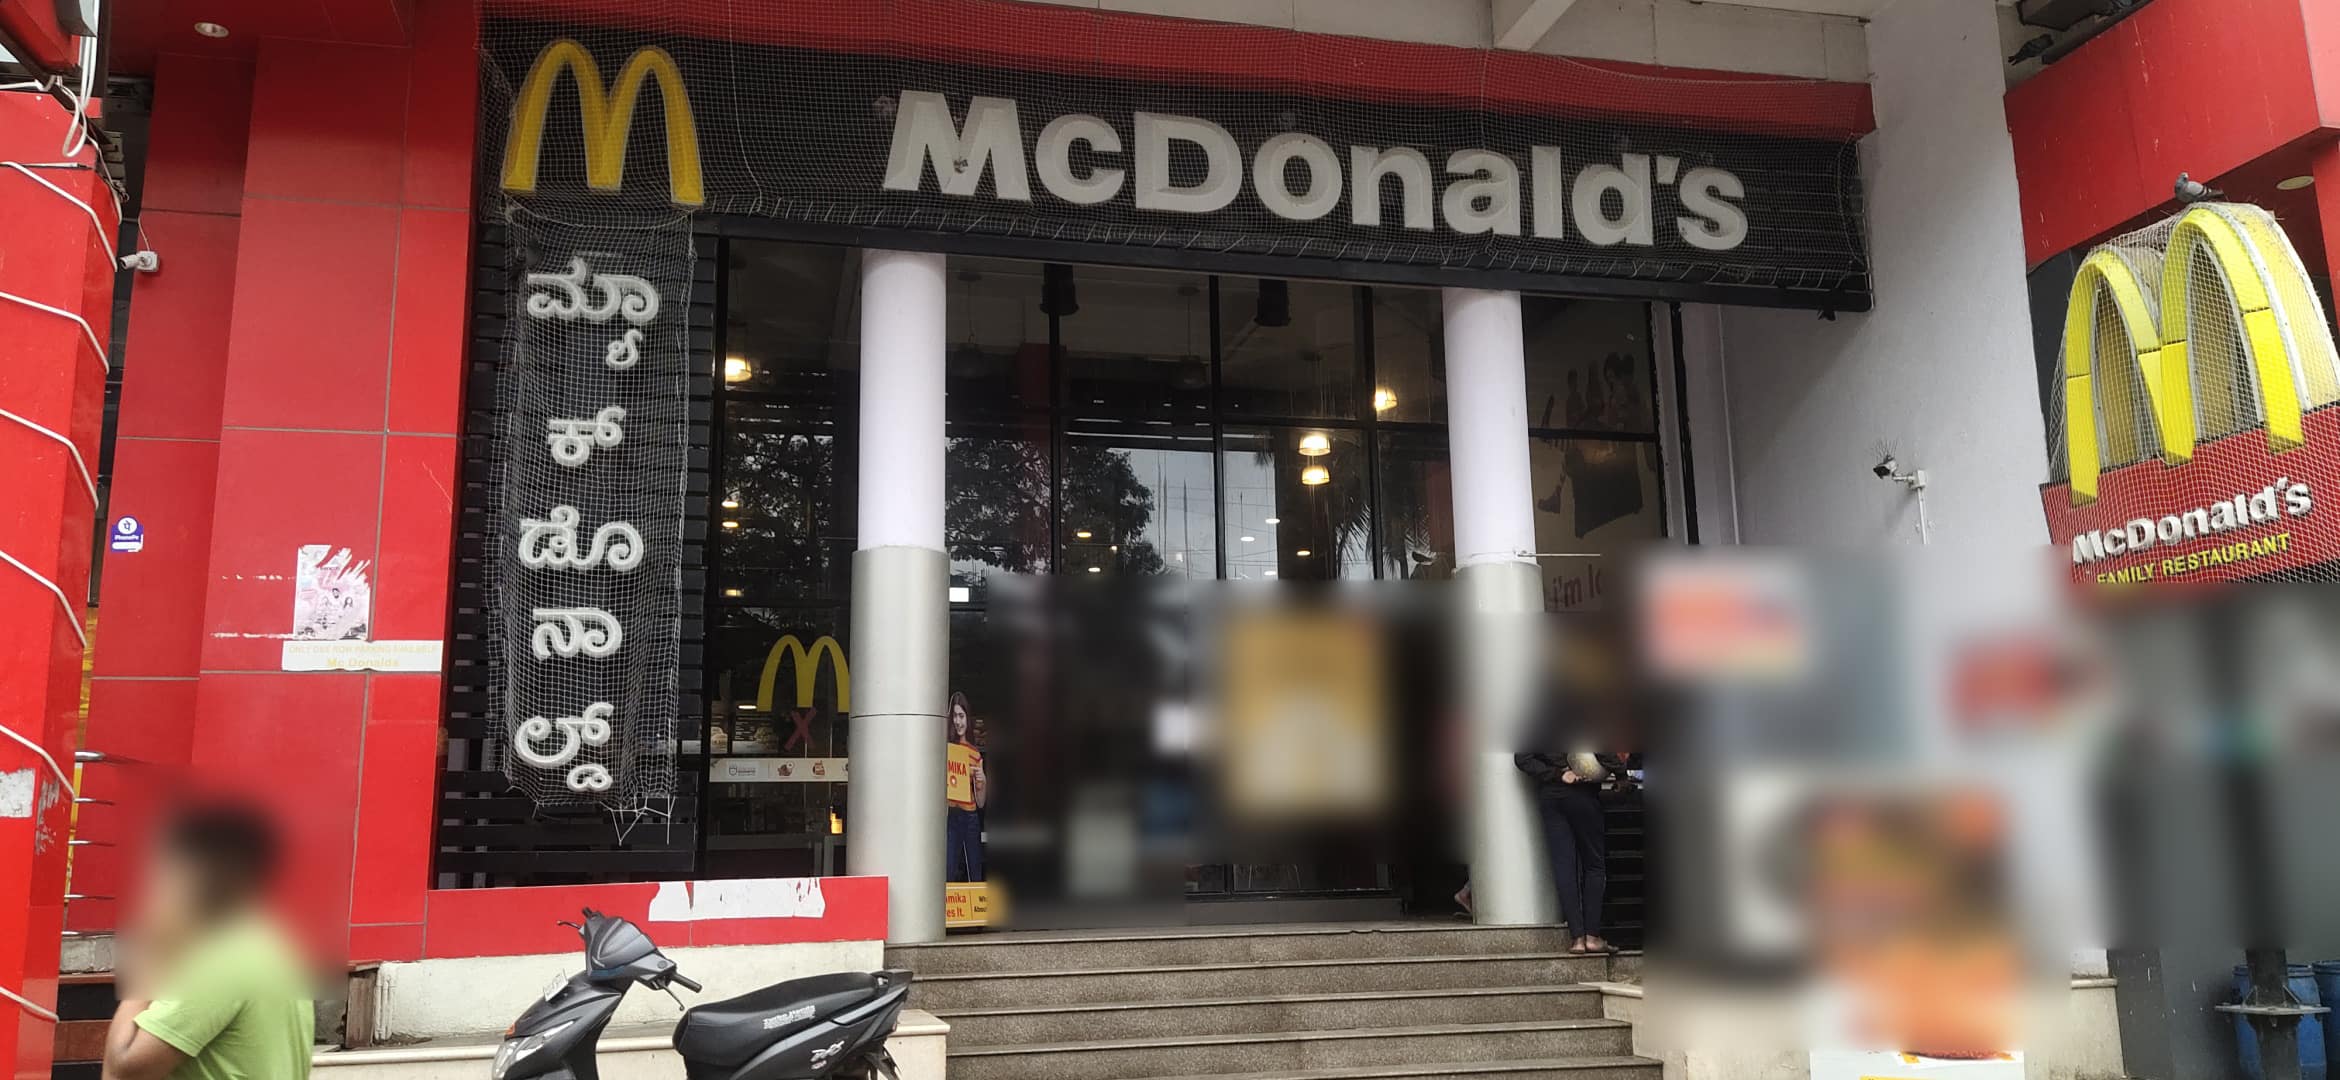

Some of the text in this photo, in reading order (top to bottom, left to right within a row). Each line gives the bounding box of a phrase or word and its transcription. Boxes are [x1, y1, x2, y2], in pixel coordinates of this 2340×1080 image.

[883, 90, 1749, 250] McDonald's
[2072, 476, 2313, 565] McDonald's
[2162, 532, 2290, 576] RESTAURANT
